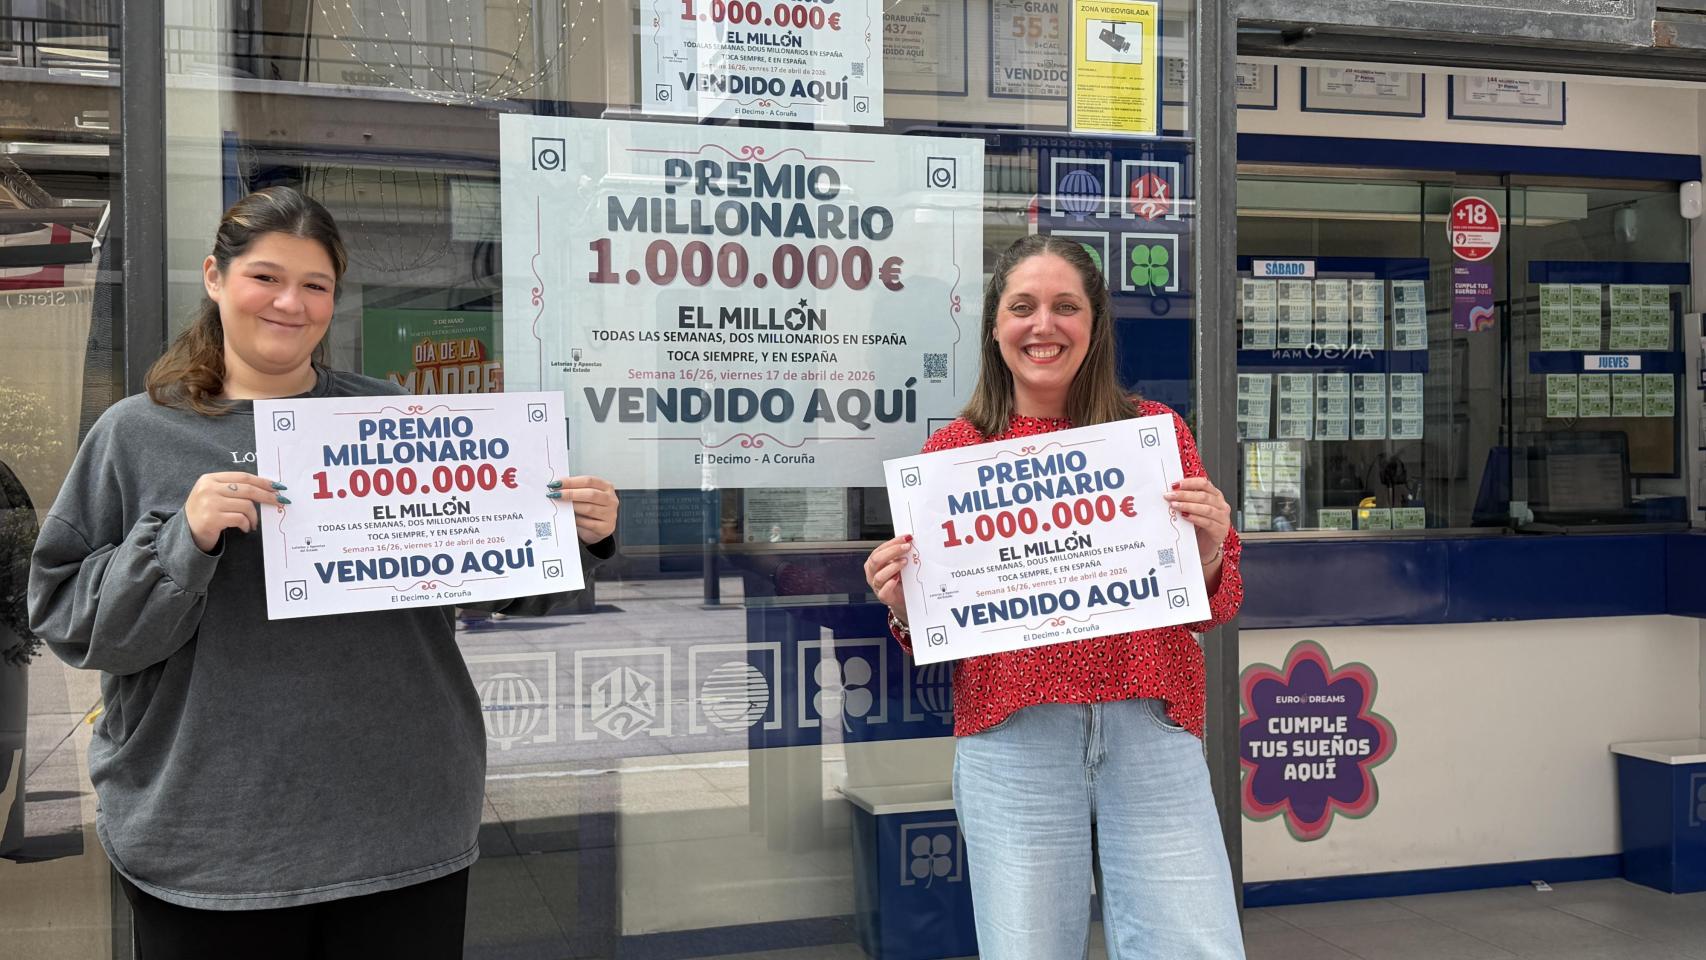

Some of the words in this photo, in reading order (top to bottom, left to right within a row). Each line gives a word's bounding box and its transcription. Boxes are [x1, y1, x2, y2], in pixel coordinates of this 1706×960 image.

[680, 0, 842, 31] 1.000.000€
[1024, 1, 1058, 14] GRAN
[1080, 5, 1099, 13] ZONA
[1100, 7, 1150, 16] VIDEOVIGILADA
[727, 31, 744, 44] EL
[739, 55, 767, 63] SEMPRE,
[782, 57, 807, 65] ESPAÑA
[747, 45, 766, 53] DOUS
[766, 46, 809, 56] MILLONARIOS
[819, 50, 844, 58] ESPAÑA
[678, 72, 786, 97] VENDIDO
[789, 75, 848, 102] AQUÍ
[741, 108, 765, 116] Decimo
[775, 110, 798, 118] Coruña
[664, 158, 841, 201] PREMIO
[607, 195, 894, 241] MILLONARIO
[1456, 203, 1487, 225] +18
[588, 237, 905, 292] 1.000.000€
[1265, 260, 1306, 275] SÁBADO
[678, 305, 713, 329] EL
[592, 330, 635, 342] TODAS
[638, 331, 660, 342] LAS
[663, 331, 727, 345] SEMANAS,
[729, 332, 754, 344] DOS
[757, 333, 840, 345] MILLONARIOS
[843, 334, 859, 345] EN
[862, 333, 908, 346] ESPAÑA
[415, 339, 436, 363] DÍA
[440, 341, 456, 360] DE
[460, 339, 477, 359] LA
[667, 350, 700, 362] TOCA
[702, 351, 759, 364] SIEMPRE,
[761, 352, 768, 362] Y
[772, 352, 788, 362] EN
[791, 350, 838, 363] ESPAÑA
[1598, 356, 1629, 369] JUEVES
[628, 369, 676, 380] Semana
[679, 368, 717, 381] 16/26,
[720, 370, 763, 381] viernes
[766, 371, 779, 380] 17
[783, 370, 797, 381] de
[800, 370, 827, 381] abril
[829, 371, 844, 381] de
[847, 371, 876, 381] 2026
[583, 386, 795, 423] VENDIDO
[802, 376, 917, 431] AQUÍ
[358, 415, 474, 441] PREMIO
[323, 438, 510, 467] MILLONARIO
[694, 454, 704, 464] El
[707, 454, 751, 465] Decimo
[762, 454, 771, 464] A
[773, 453, 815, 464] Coruña
[977, 450, 1087, 487] PREMIO
[312, 463, 519, 500] 1.000.000€
[947, 467, 1125, 516] MILLONARIO
[318, 523, 346, 532] TODAS
[347, 522, 363, 530] LAS
[364, 520, 406, 529] SEMANAS,
[407, 519, 425, 527] DOS
[426, 515, 480, 526] MILLONARIOS
[494, 511, 524, 521] ESPAÑA
[373, 505, 396, 520] EL
[941, 494, 1138, 548] 1.000.000€
[368, 532, 390, 541] TOCA
[391, 530, 429, 539] SIEMPRE,
[449, 526, 481, 536] ESPAÑA
[342, 546, 375, 554] Semana
[377, 544, 403, 552] 16/26,
[404, 541, 433, 550] viernes
[434, 540, 443, 548] 17
[445, 539, 455, 547] de
[456, 538, 473, 546] abril
[487, 536, 505, 544] 2026
[999, 547, 1021, 562] EL
[313, 553, 455, 584] VENDIDO
[460, 538, 535, 575] AQUÍ
[951, 568, 985, 579] TÓDALAS
[986, 560, 1026, 573] SEMANAS,
[1026, 557, 1049, 567] DOUS
[1049, 549, 1102, 563] MILLONARIOS
[1103, 546, 1114, 554] EN
[1115, 541, 1146, 552] ESPAÑA
[997, 574, 1018, 583] TOCA
[1019, 568, 1053, 579] SEMPRE,
[1059, 564, 1070, 573] EN
[1071, 559, 1102, 571] ESPAÑA
[975, 588, 1005, 597] Semana
[1007, 583, 1031, 593] 16/26,
[1032, 580, 1057, 588] venres
[1058, 576, 1067, 584] 17
[1069, 574, 1078, 583] de
[1080, 571, 1097, 581] abril
[1098, 570, 1108, 578] de
[1109, 567, 1128, 576] 2026
[391, 595, 399, 603] El
[400, 593, 430, 602] Decimo
[443, 590, 472, 599] Coruña
[950, 589, 1081, 628] VENDIDO
[1087, 567, 1160, 608] AQUÍ
[1031, 630, 1060, 640] Decimo
[1073, 623, 1100, 634] Coruña
[1276, 696, 1300, 704] EURO
[1309, 695, 1346, 703] DREAMS
[1268, 716, 1348, 734] CUMPLE
[1249, 740, 1288, 758] TUS
[1292, 735, 1370, 757] SUEÑOS
[1284, 758, 1337, 782] AQUÍ
